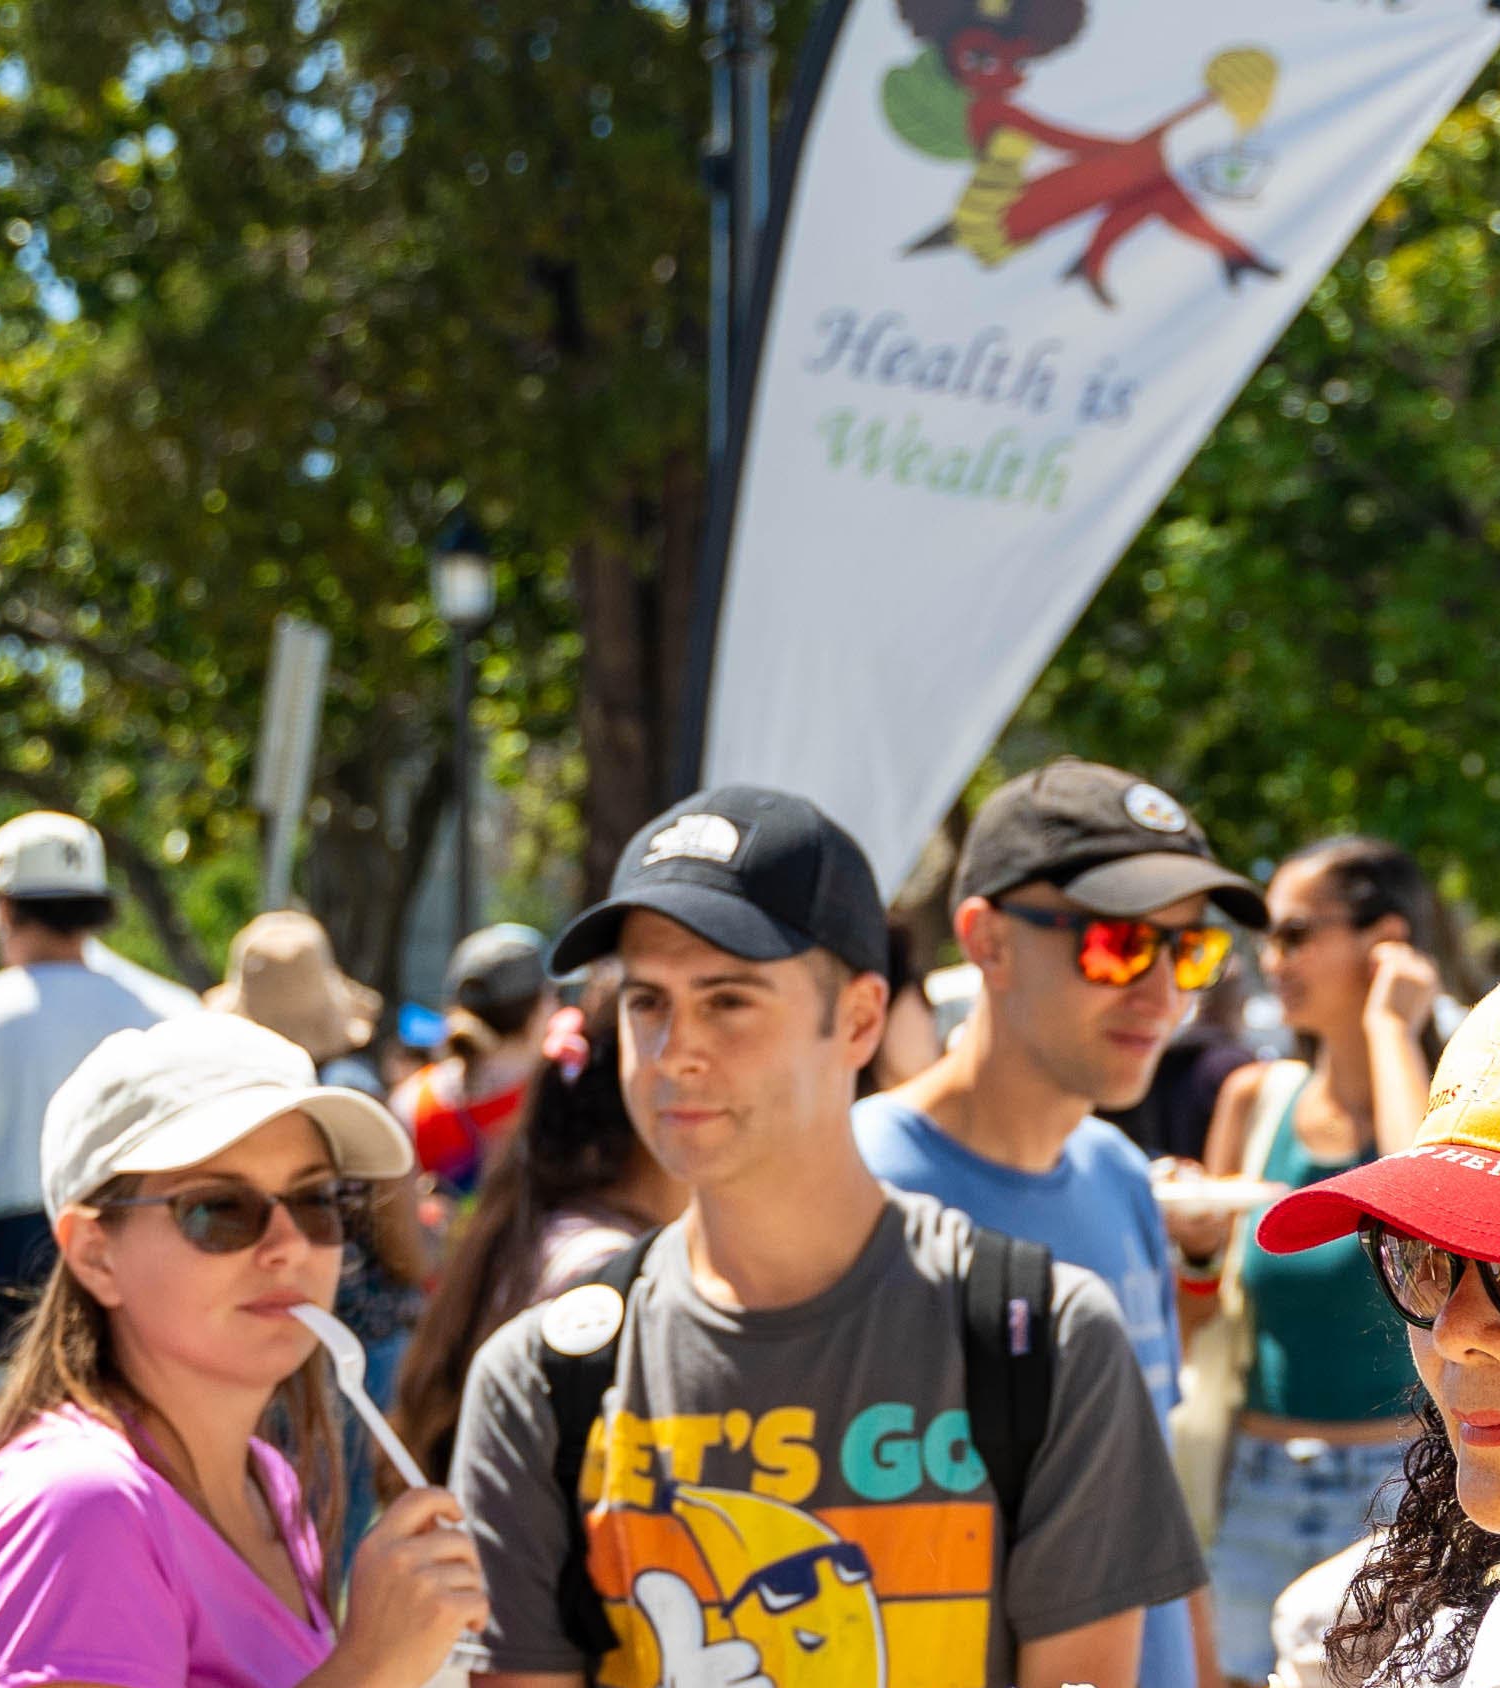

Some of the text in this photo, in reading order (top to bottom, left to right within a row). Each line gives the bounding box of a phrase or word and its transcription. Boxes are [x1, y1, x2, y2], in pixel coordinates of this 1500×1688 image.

[803, 306, 1140, 424] Health is
[812, 406, 1078, 514] Wealth
[839, 1402, 989, 1502] GO
